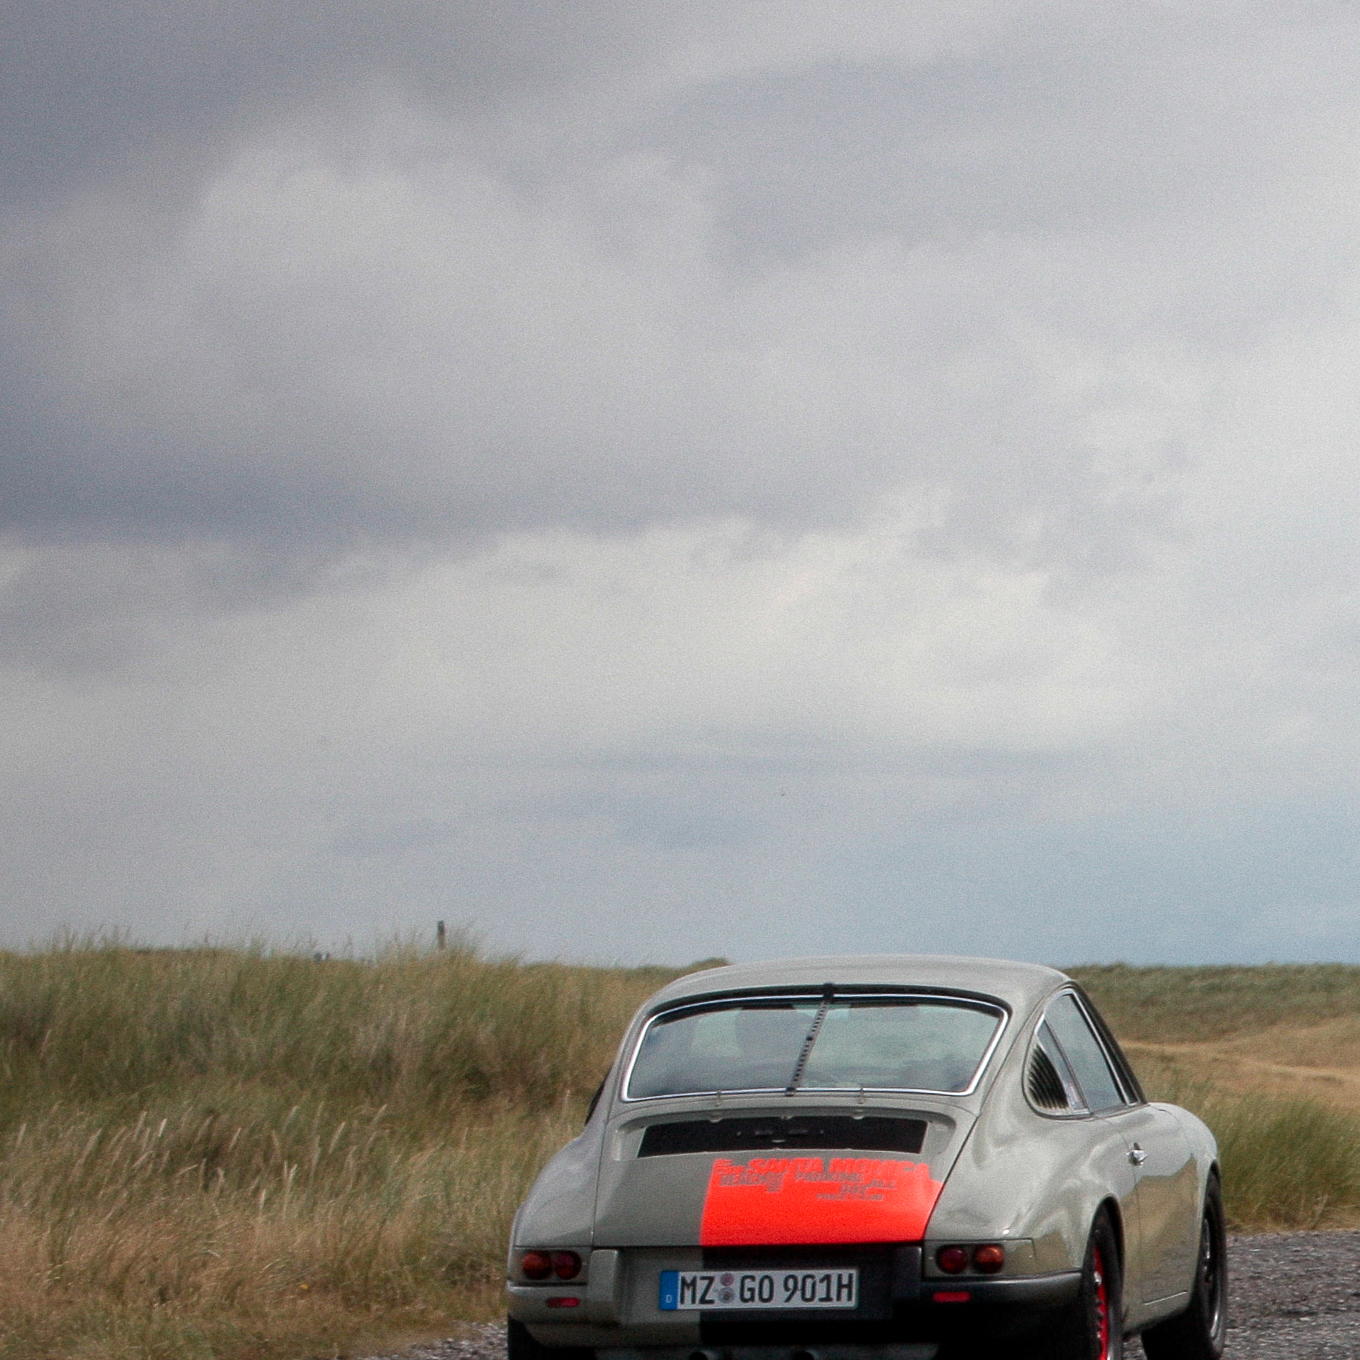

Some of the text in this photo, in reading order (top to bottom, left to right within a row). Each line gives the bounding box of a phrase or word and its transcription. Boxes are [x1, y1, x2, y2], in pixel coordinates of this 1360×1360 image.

[748, 1157, 823, 1176] SANTA
[666, 1294, 673, 1303] D
[680, 1274, 854, 1304] MZ GO 901H
